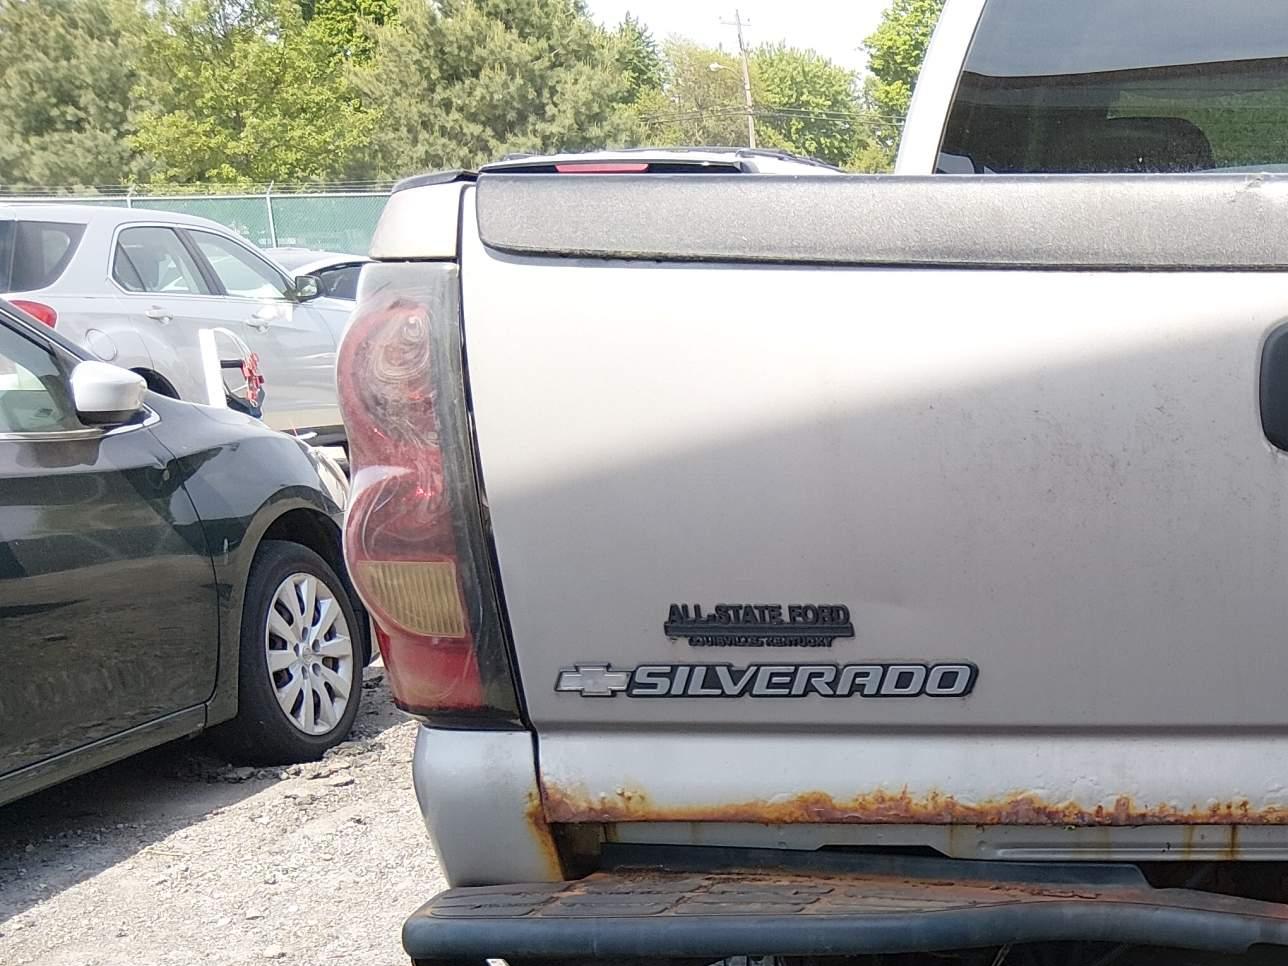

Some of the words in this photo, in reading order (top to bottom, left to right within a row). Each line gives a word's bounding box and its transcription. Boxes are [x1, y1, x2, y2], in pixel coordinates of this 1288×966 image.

[667, 603, 783, 625] ALL-STATE
[788, 603, 851, 625] FORD
[629, 664, 978, 698] SILVERADO
